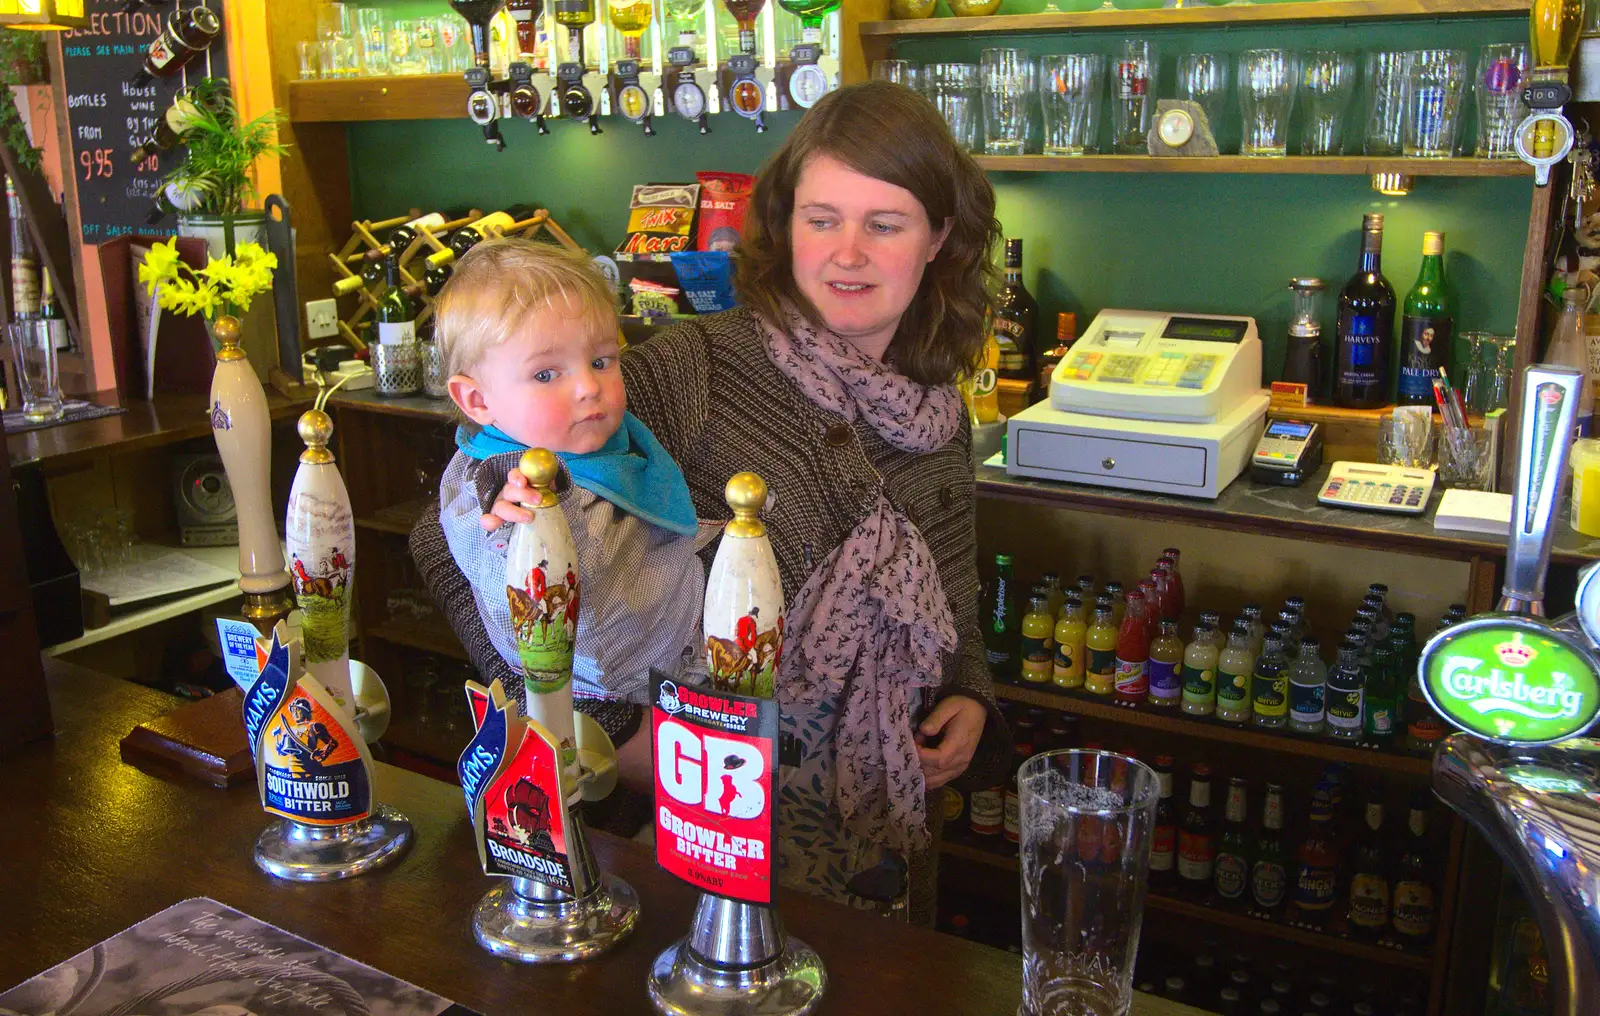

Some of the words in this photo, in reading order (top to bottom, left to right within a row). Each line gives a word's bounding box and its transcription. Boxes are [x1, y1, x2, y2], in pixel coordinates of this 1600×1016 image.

[64, 46, 91, 57] PLEASE
[96, 44, 110, 56] SEE
[113, 44, 134, 55] MAIN
[122, 81, 157, 97] HOUSE
[68, 93, 107, 108] BOTTLES
[131, 101, 155, 111] WINE
[78, 126, 102, 140] FROM
[126, 117, 140, 134] BY
[714, 202, 736, 210] SALT
[83, 224, 100, 236] OFF
[623, 232, 689, 254] Mars
[637, 300, 669, 313] FRIES
[1344, 335, 1380, 344] HARVEYS
[1402, 366, 1420, 377] PALE
[1422, 367, 1440, 378] DRY
[227, 633, 253, 645] BREWERY
[1441, 656, 1583, 718] Carlsberg
[677, 685, 758, 718] GROWLER
[684, 703, 748, 724] BREWERY
[657, 720, 765, 820] GB
[266, 772, 350, 800] SOUTHWOLD
[284, 797, 332, 812] BITTER
[659, 806, 764, 860] GROWLER
[487, 839, 567, 878] BROADSIDE
[676, 836, 737, 870] BITTER
